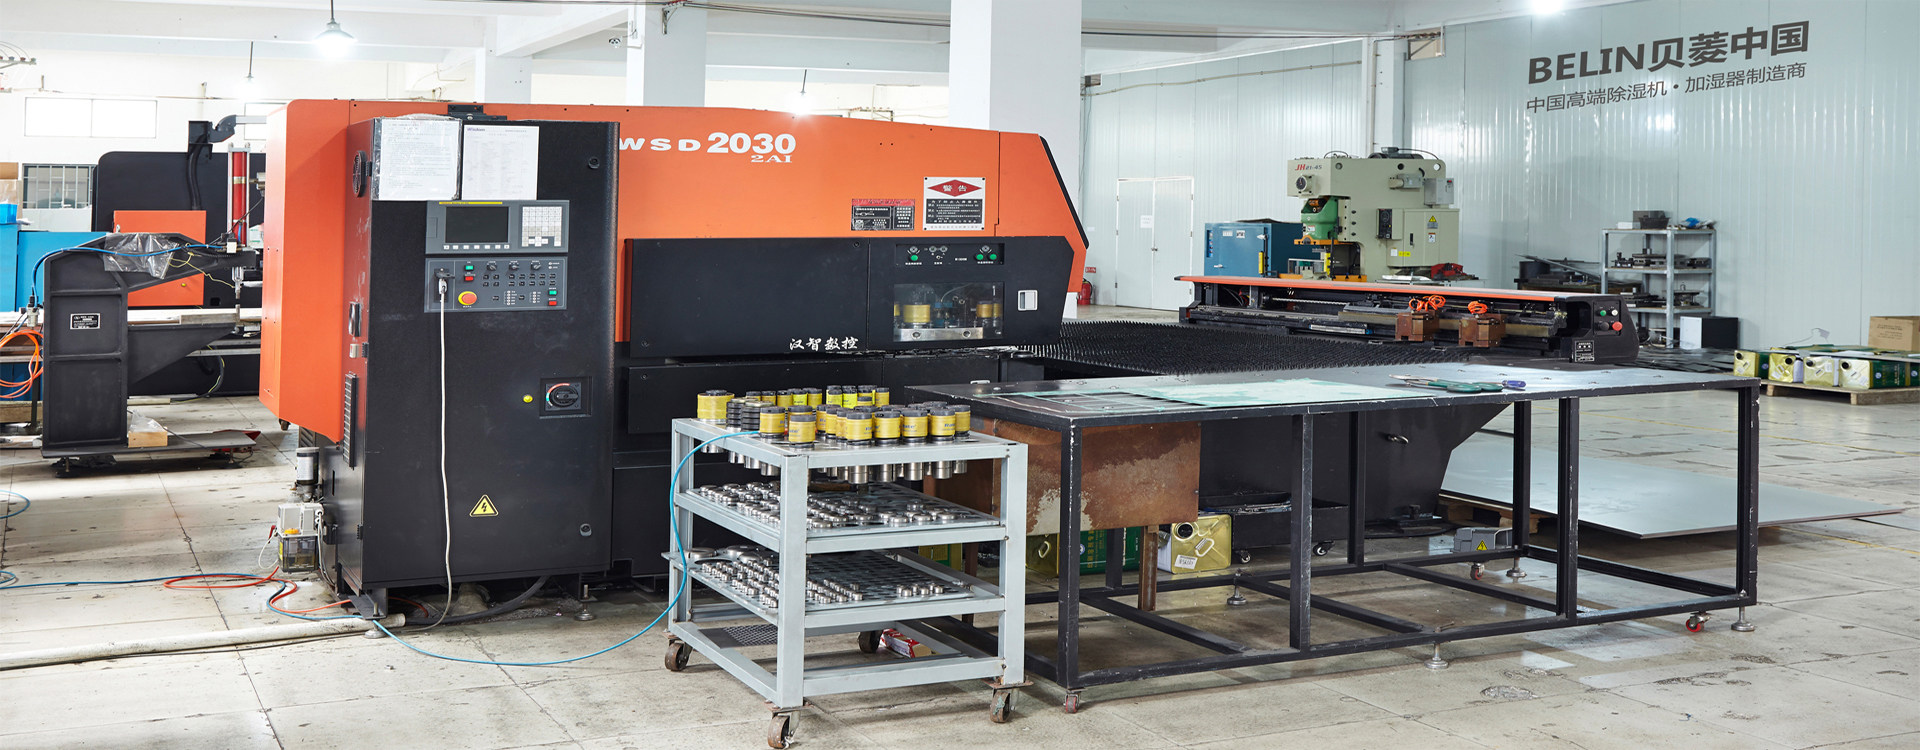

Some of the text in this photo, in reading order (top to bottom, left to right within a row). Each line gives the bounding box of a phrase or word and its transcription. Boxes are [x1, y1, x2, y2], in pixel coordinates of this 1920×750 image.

[706, 132, 797, 154] 2030
[942, 184, 967, 192] 警告
[789, 336, 859, 352] 汉智数控
